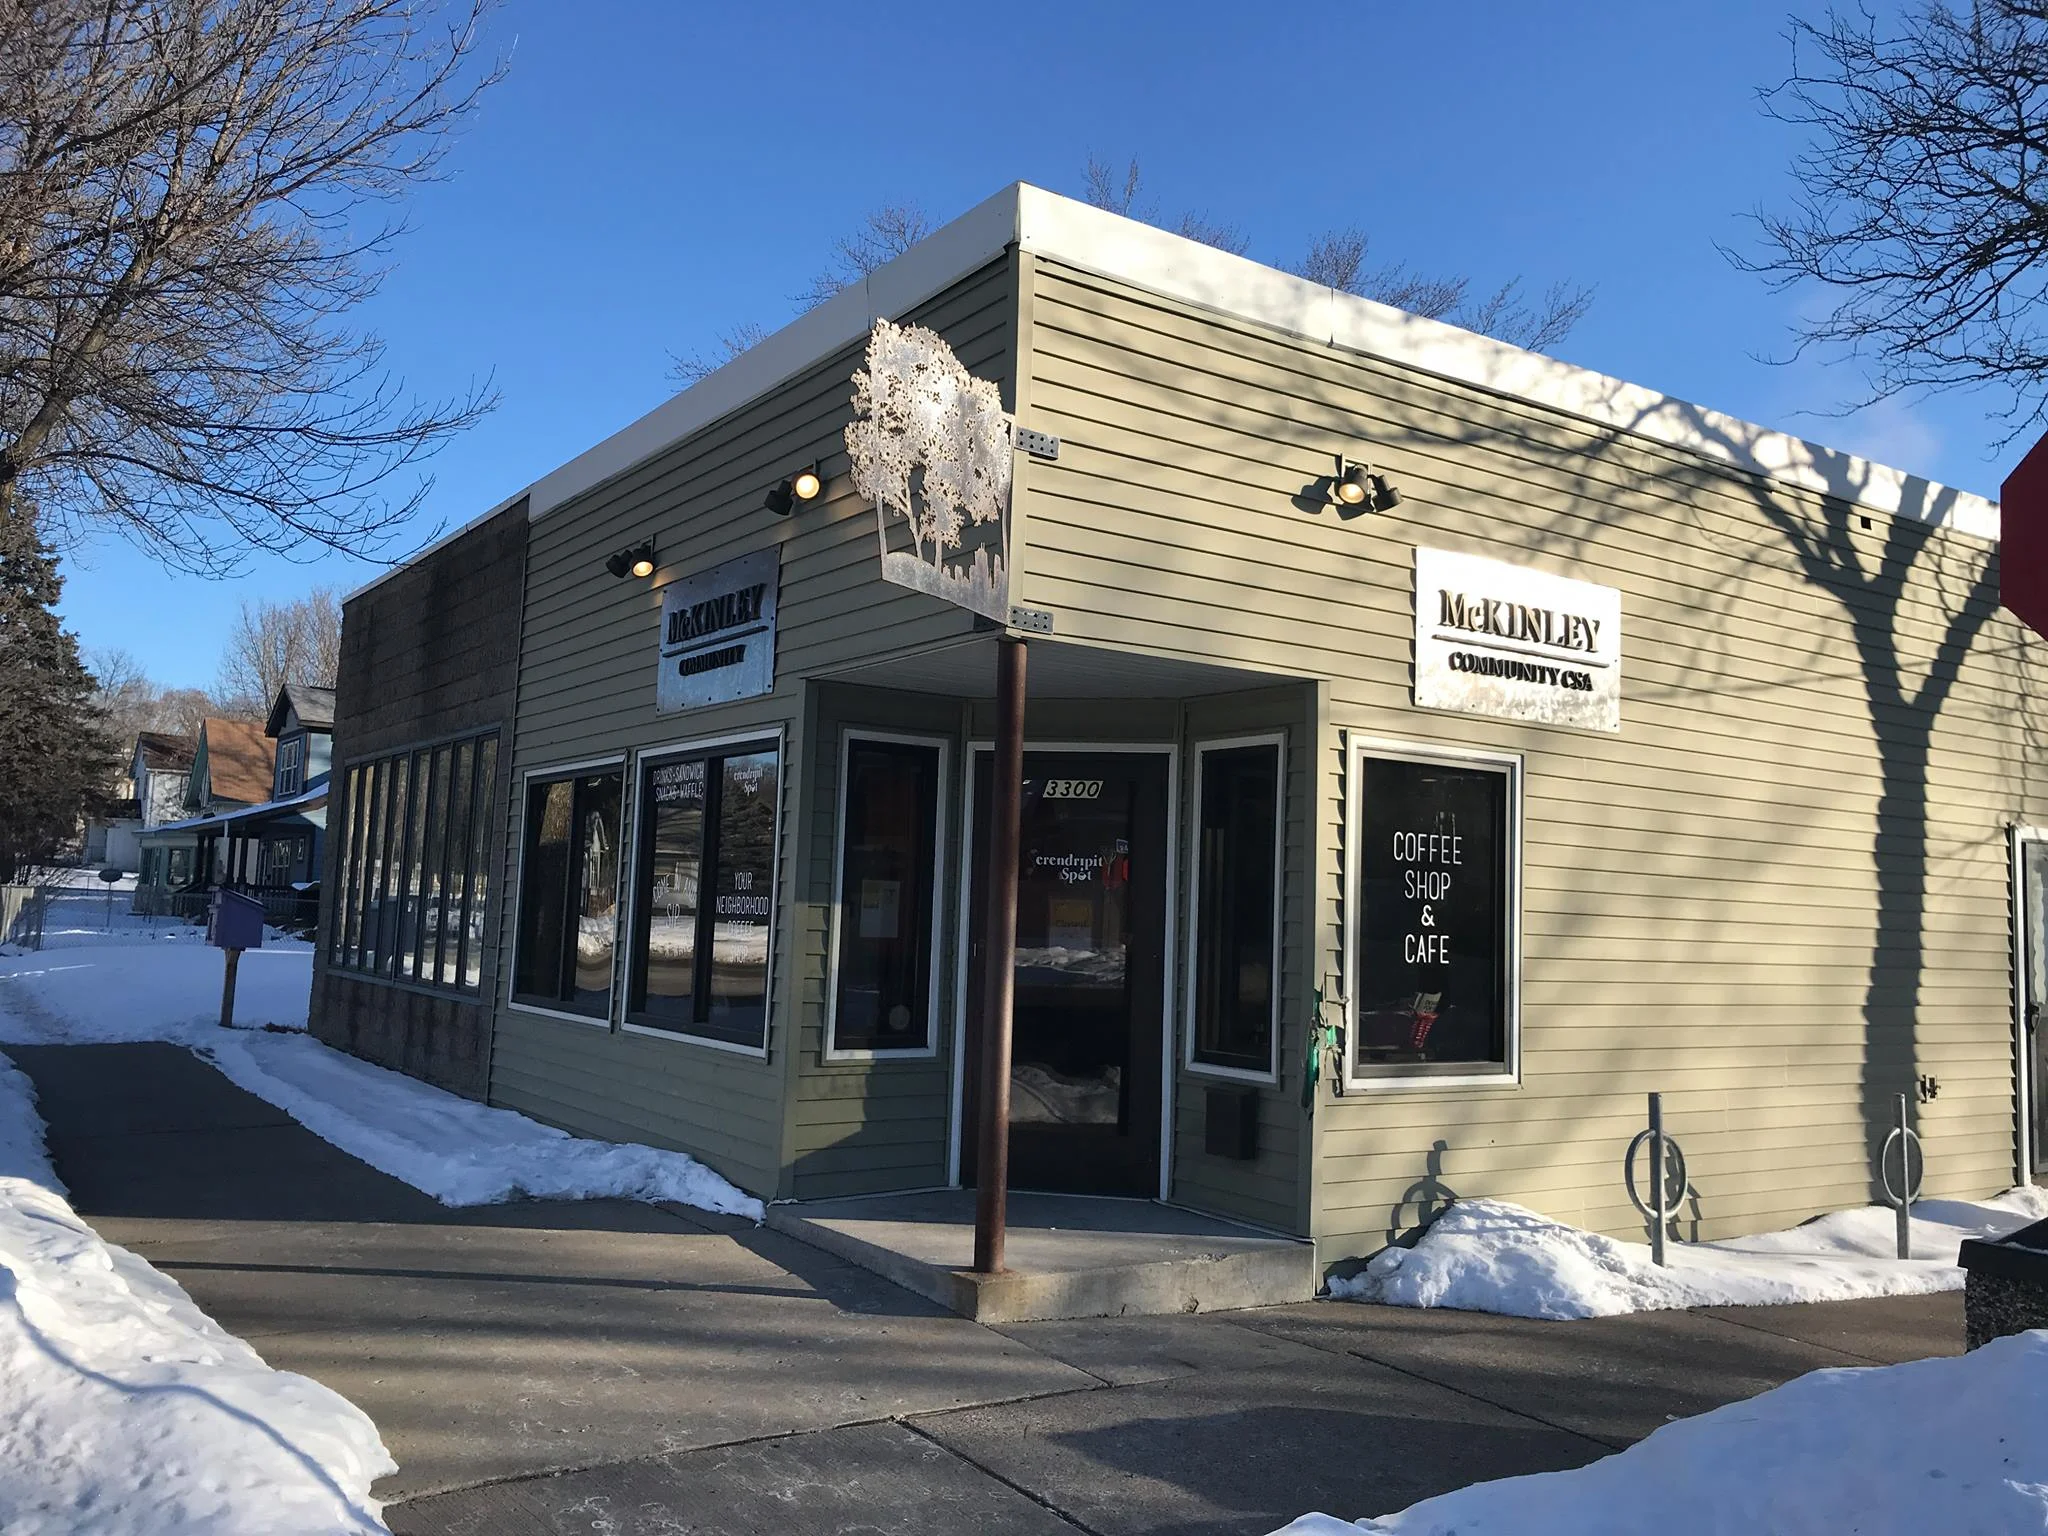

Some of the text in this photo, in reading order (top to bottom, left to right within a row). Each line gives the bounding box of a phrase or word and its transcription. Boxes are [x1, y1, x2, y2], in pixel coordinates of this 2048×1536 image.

[666, 583, 768, 645] McKINLEY
[1438, 589, 1601, 653] McKINLEY
[678, 644, 748, 677] COMMUNITY
[1448, 651, 1594, 692] COMMUNITY CSA
[1046, 781, 1101, 798] 3300
[1393, 831, 1463, 865] COFFEE
[734, 871, 753, 890] YOUR
[1404, 869, 1451, 900] SHOP
[715, 895, 769, 915] NEIGHBORHOOD
[1421, 904, 1436, 927] &
[1404, 933, 1450, 964] CAFE
